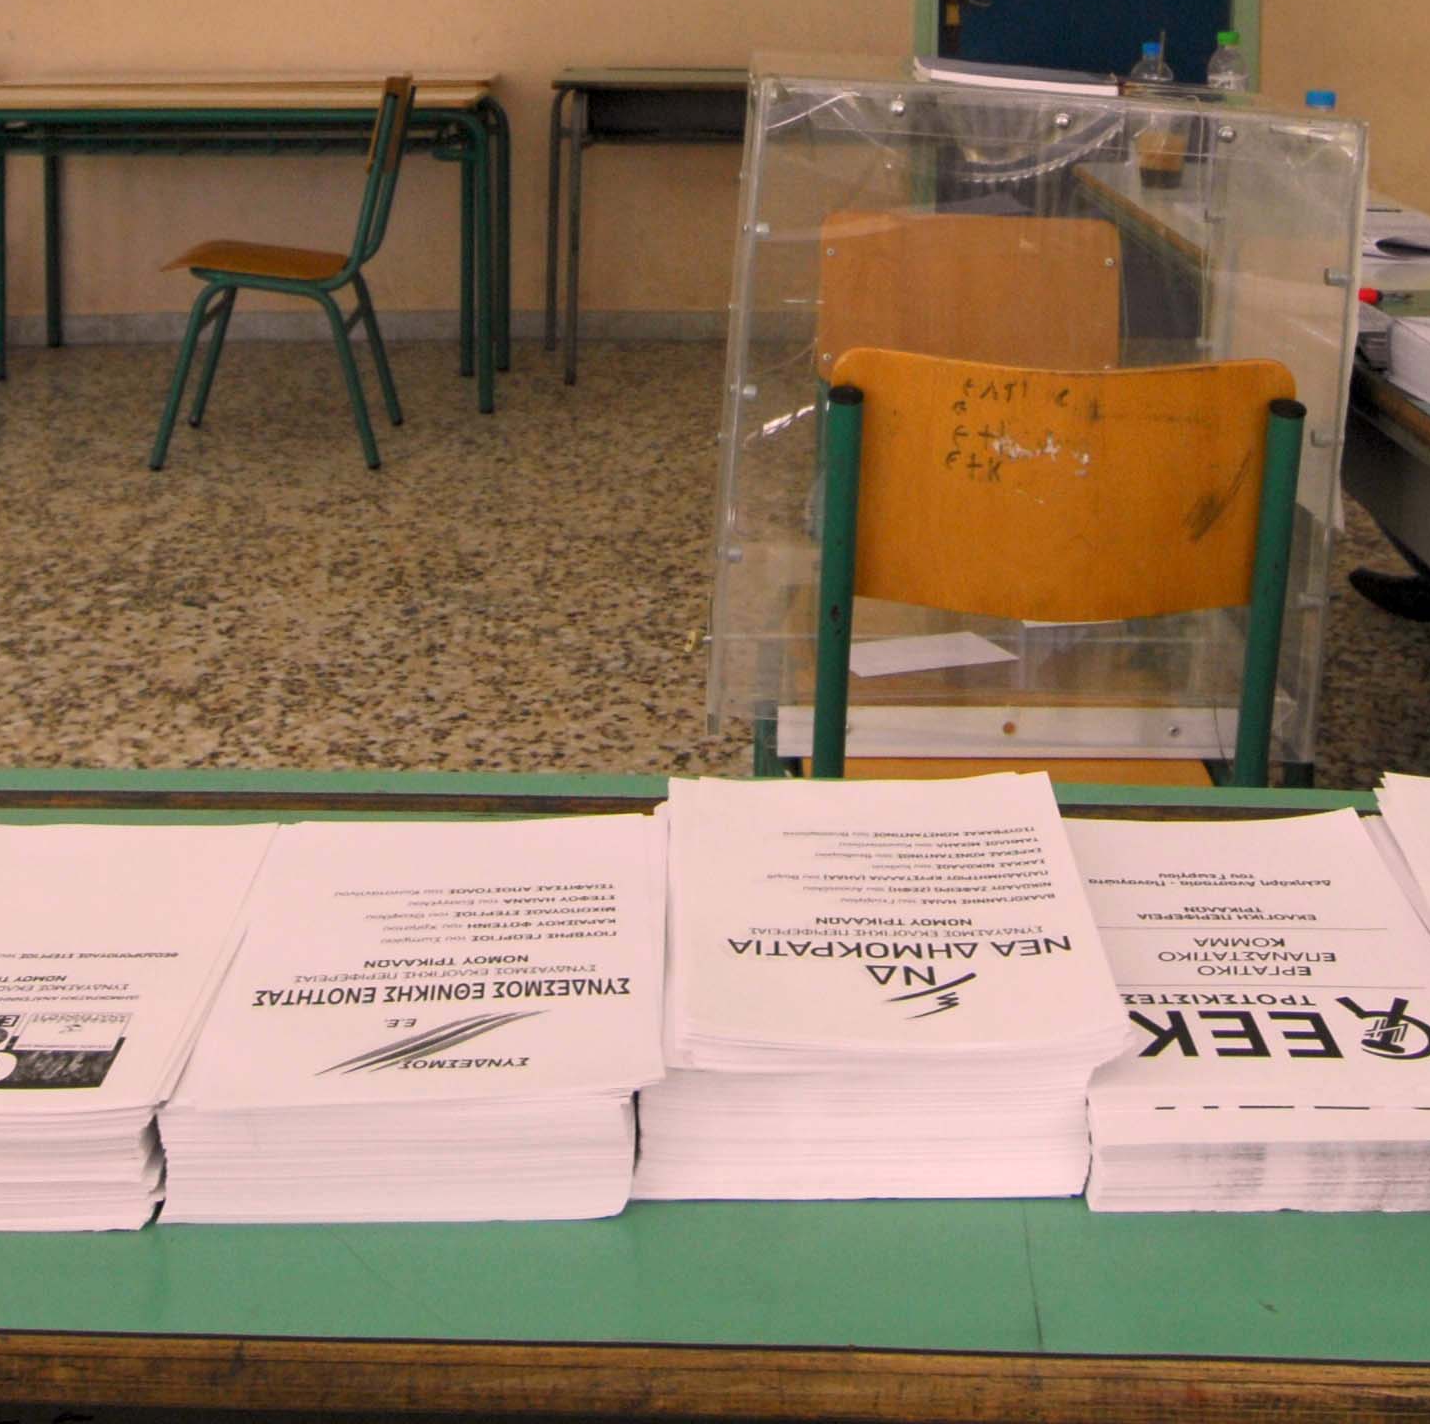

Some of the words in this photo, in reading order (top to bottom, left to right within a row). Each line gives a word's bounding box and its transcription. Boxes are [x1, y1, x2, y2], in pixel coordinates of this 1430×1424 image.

[1182, 906, 1263, 914] ΤΡΙΚΑΛΩΝ
[815, 917, 905, 926] ΤΡΙΚΑΛΩΝ
[910, 918, 973, 927] ΝΟΜΟΥ
[1136, 913, 1233, 921] ΠΕΡΙΦΕΡΕΙΑ
[747, 927, 851, 936] ΠΕΡΙΦΕΡΕΙΑΣ
[852, 929, 939, 938] ΕΚΛΟΓΙΚΗΣ
[942, 926, 1044, 938] ΣΥΝΔΥΑΣΜΟΣ
[726, 938, 979, 960] ΔΗΜΟΚΡΑΤΙΑ
[989, 935, 1073, 958] ΝΕΑ
[1192, 937, 1286, 949] ΚΟΜΜΑ
[362, 957, 456, 969] ΤΡΙΚΑΛΩΝ
[461, 955, 530, 967] ΝΟΜΟΥ
[1157, 951, 1337, 963] ΕΠΑΝΑΣΤΑΤΙΚΟ
[403, 967, 490, 979] ΕΚΛΟΓΙΚΗΣ
[494, 964, 597, 975] ΣΥΝΔΥΑΣΜΟΣ
[1196, 965, 1313, 977] ΕΡΓΑΤΙΚΟ
[13, 975, 68, 983] ΝΟΜΟΥ
[292, 971, 399, 984] ΠΕΡΙΦΕΡΕΙΑΣ
[865, 965, 937, 987] ΝΔ
[381, 981, 487, 1005] ΕΘΝΙΚΗΣ
[491, 978, 632, 1000] ΣΥΝΔΕΣΜΟΣ
[250, 986, 377, 1008] ΕΝΟΤΗΤΑΣ
[1119, 993, 1317, 1007] ΤΡΟΤΣΚΙΣΤΕΣ
[383, 1018, 418, 1028] Ε.Ε.
[1127, 1009, 1345, 1060] ΕΕΚ
[397, 1057, 530, 1070] ΣΥΝΔΕΣΜΟΣ
